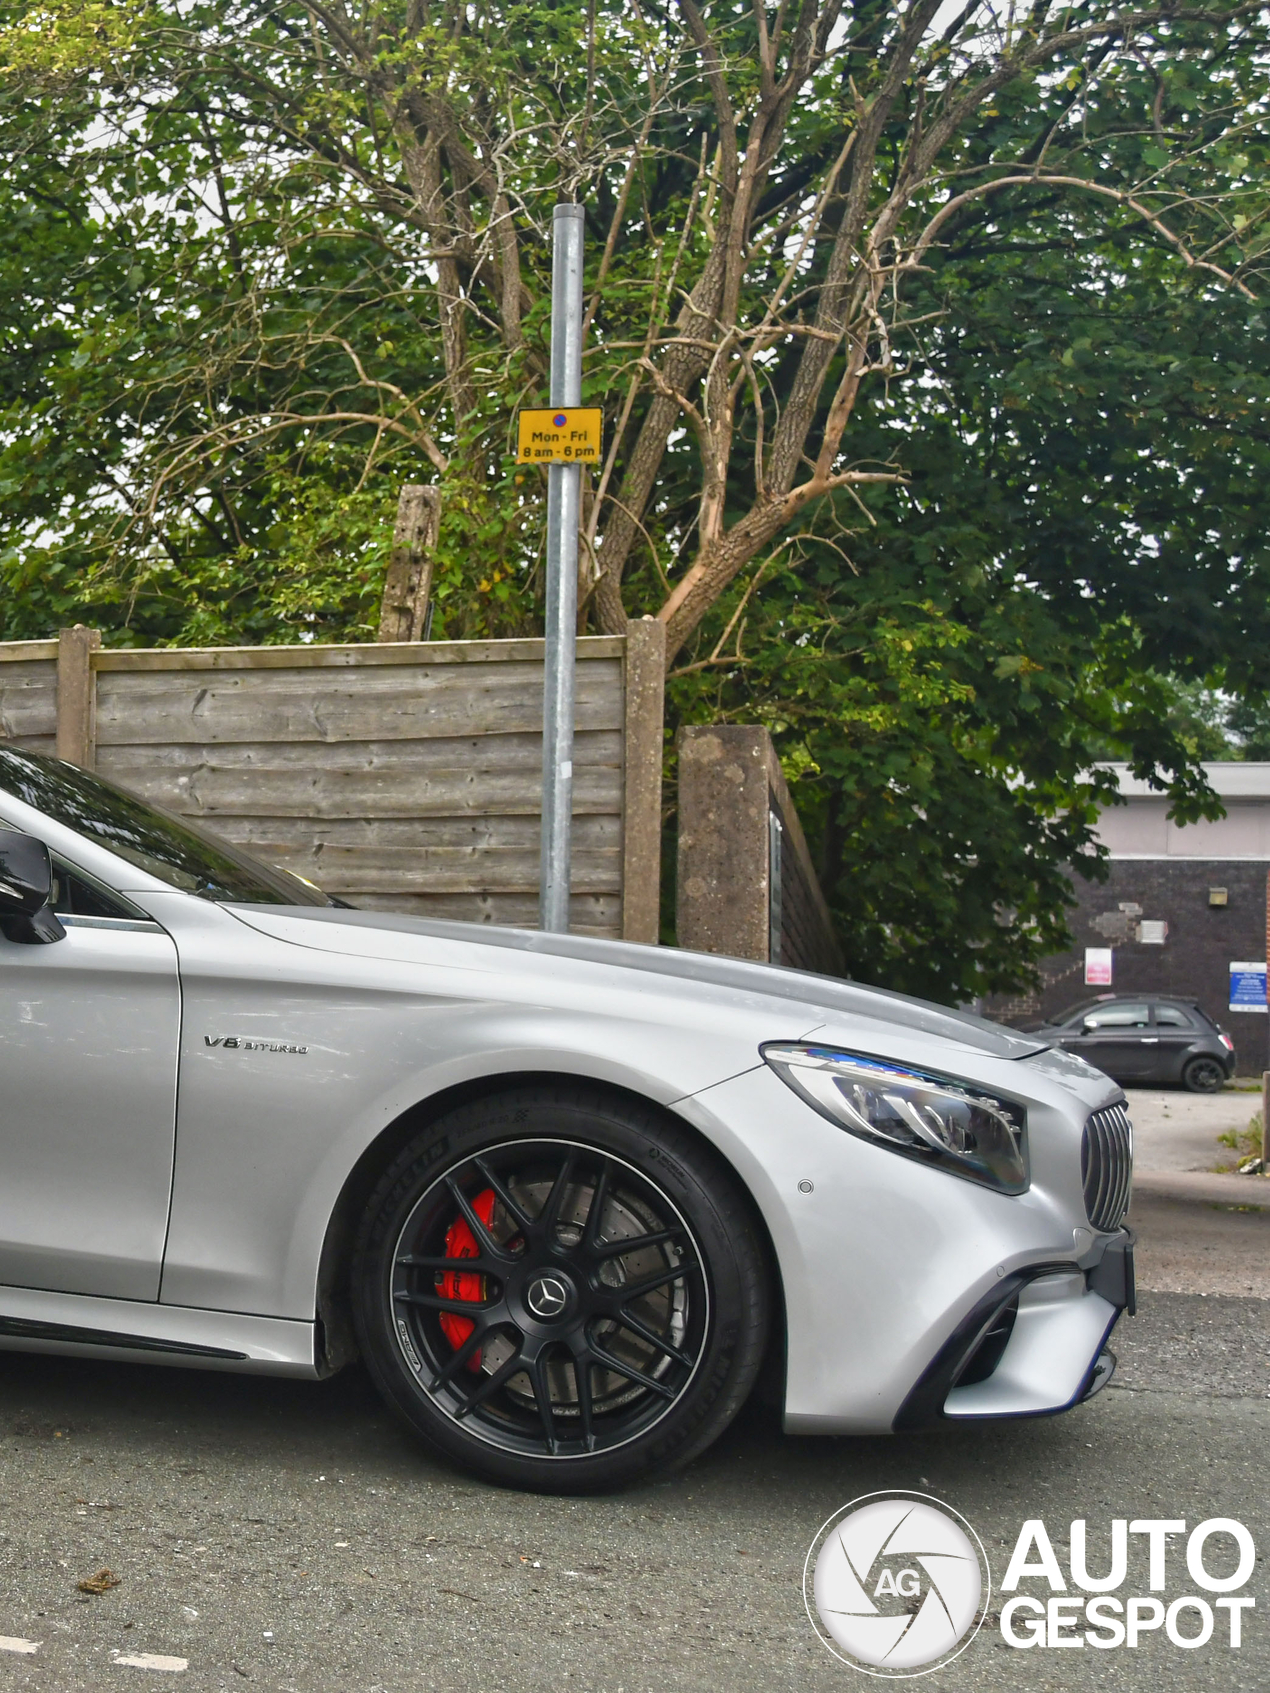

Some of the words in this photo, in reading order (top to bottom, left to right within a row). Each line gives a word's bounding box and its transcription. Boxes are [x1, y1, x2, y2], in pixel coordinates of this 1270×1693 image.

[531, 432, 559, 442] Mon
[570, 431, 588, 441] Fri
[523, 447, 531, 457] 8
[534, 448, 553, 457] am
[564, 446, 572, 456] 6
[575, 447, 595, 458] pm
[204, 1035, 241, 1049] V8
[244, 1042, 309, 1055] BITURBO
